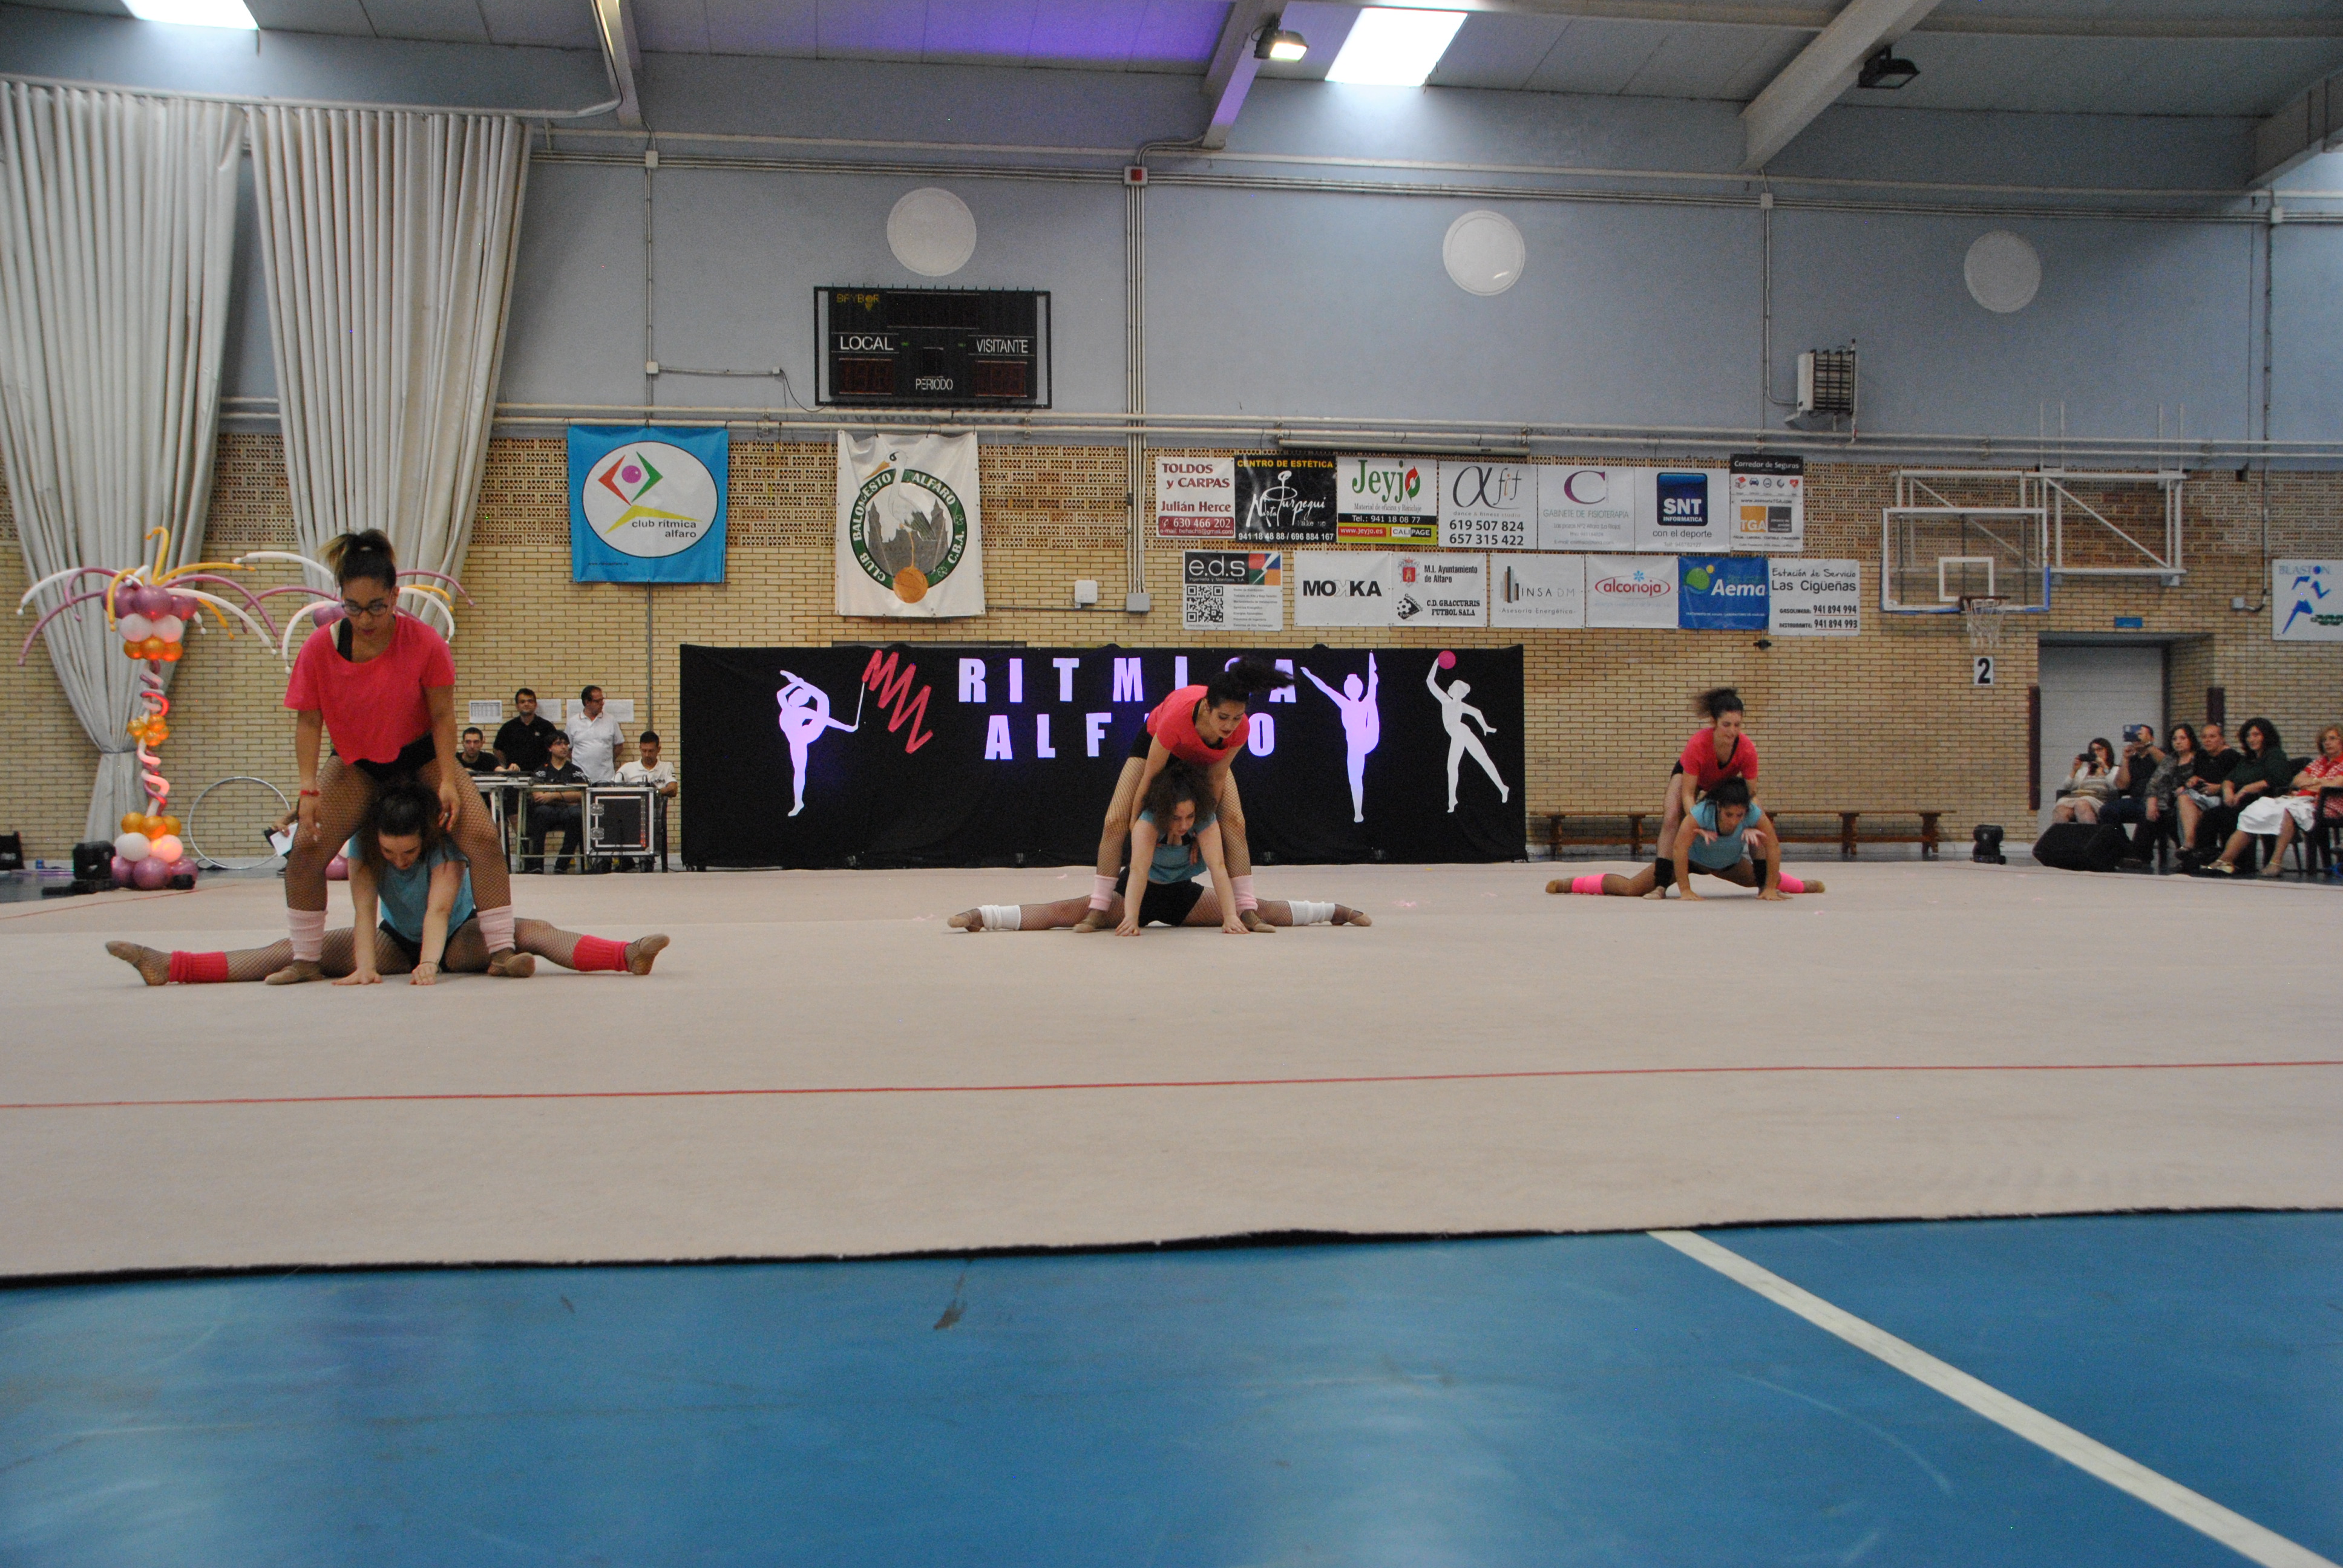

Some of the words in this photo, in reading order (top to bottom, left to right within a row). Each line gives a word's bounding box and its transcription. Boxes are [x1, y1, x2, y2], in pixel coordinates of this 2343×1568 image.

[841, 336, 894, 350] LOCAL
[977, 339, 1028, 353] VISITANTE
[916, 378, 953, 390] PERIODO
[1162, 463, 1213, 474] TOLDOS
[1166, 480, 1174, 489] y
[1178, 478, 1230, 488] CARPAS
[1564, 470, 1606, 505] C
[1161, 500, 1195, 512] Julián
[1199, 501, 1231, 512] Herce
[1663, 498, 1702, 515] SNT
[632, 520, 655, 528] club
[658, 519, 696, 528] rítmica
[859, 552, 886, 582] CLUB
[912, 472, 956, 506] ALFARO
[1173, 518, 1190, 527] 630
[1194, 518, 1210, 528] 466
[1214, 518, 1230, 528] 202
[1449, 520, 1472, 530] 619
[1476, 520, 1498, 531] 507
[1501, 521, 1524, 532] 824
[1741, 520, 1766, 531] TGA
[665, 529, 696, 538] alfaro
[1680, 530, 1712, 539] deporte
[1449, 534, 1472, 544] 657
[1476, 535, 1498, 544] 315
[1501, 535, 1524, 546] 422
[1438, 566, 1478, 574] Ayuntamiento
[1772, 568, 1806, 577] Estación
[1823, 569, 1856, 578] Servicio
[1710, 579, 1766, 596] Aema
[1772, 580, 1793, 590] Las
[1800, 580, 1856, 594] Cigüeñas
[1814, 606, 1825, 614] 941
[1827, 606, 1841, 614] 894
[1843, 606, 1857, 614] 994
[1814, 619, 1826, 628] 941
[1829, 619, 1842, 628] 894
[1844, 619, 1858, 629] 993
[1978, 658, 1991, 684] 2
[959, 656, 1297, 704] RITMIA
[985, 713, 1275, 760] ALFO
